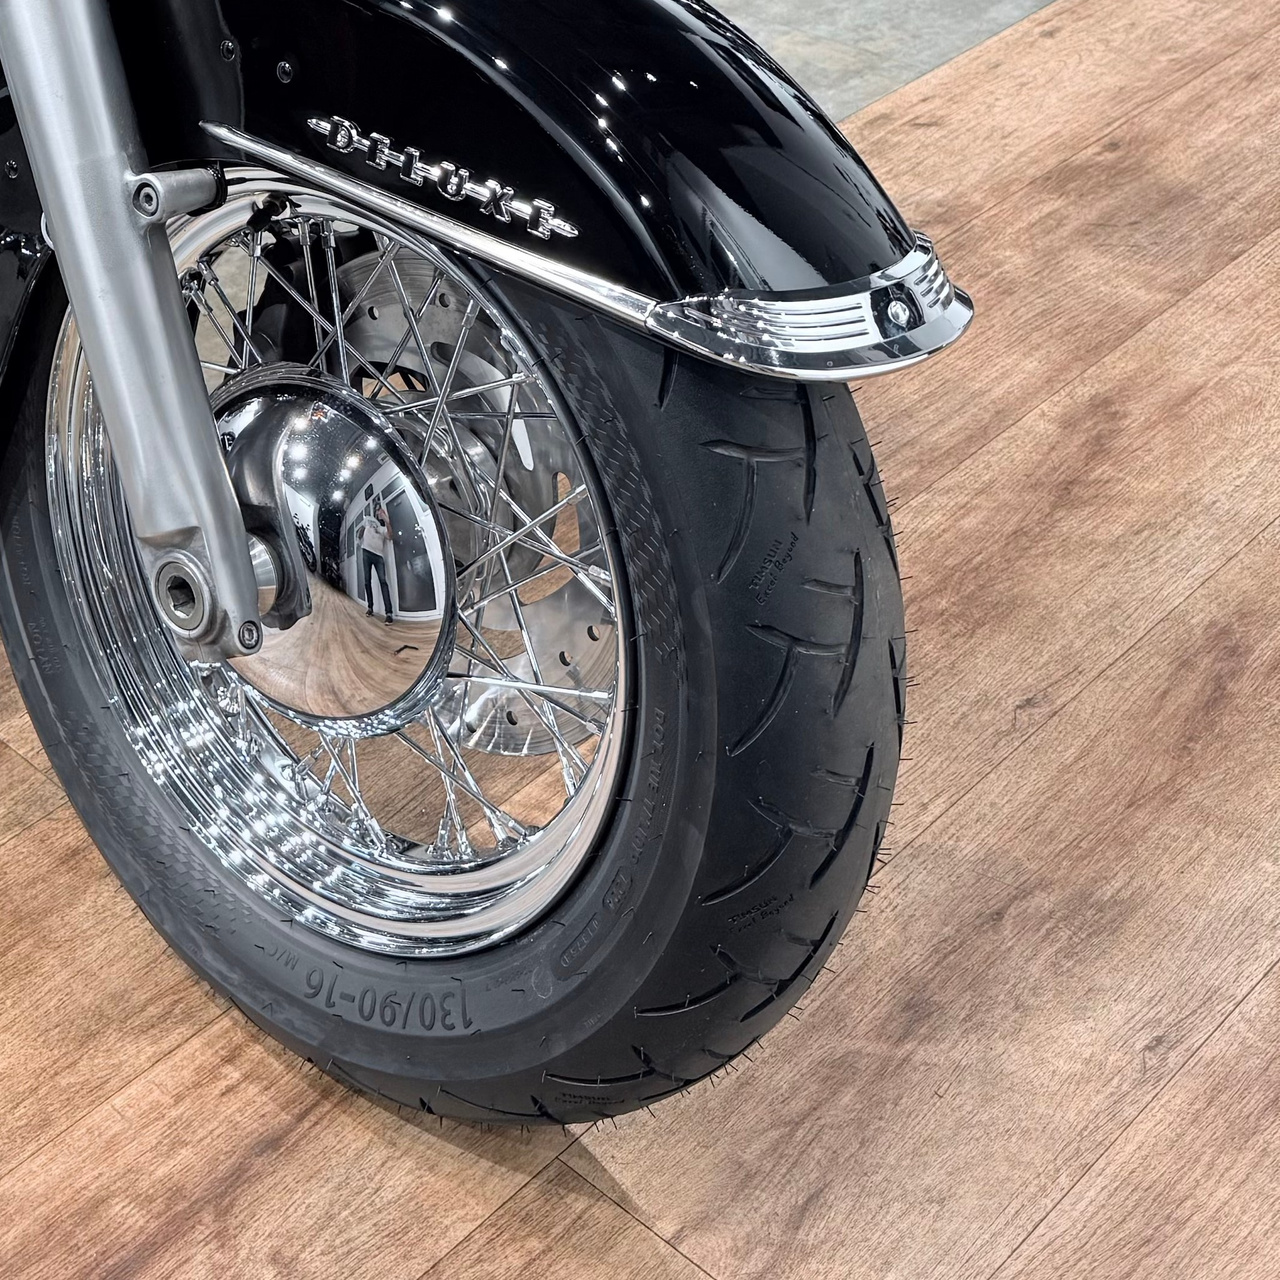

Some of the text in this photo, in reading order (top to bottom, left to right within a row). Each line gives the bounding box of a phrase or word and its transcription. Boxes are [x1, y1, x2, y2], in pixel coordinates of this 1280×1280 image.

[320, 115, 562, 242] DELUXE
[749, 539, 783, 589] TIMSUN
[303, 968, 474, 1031] 130/90-16
